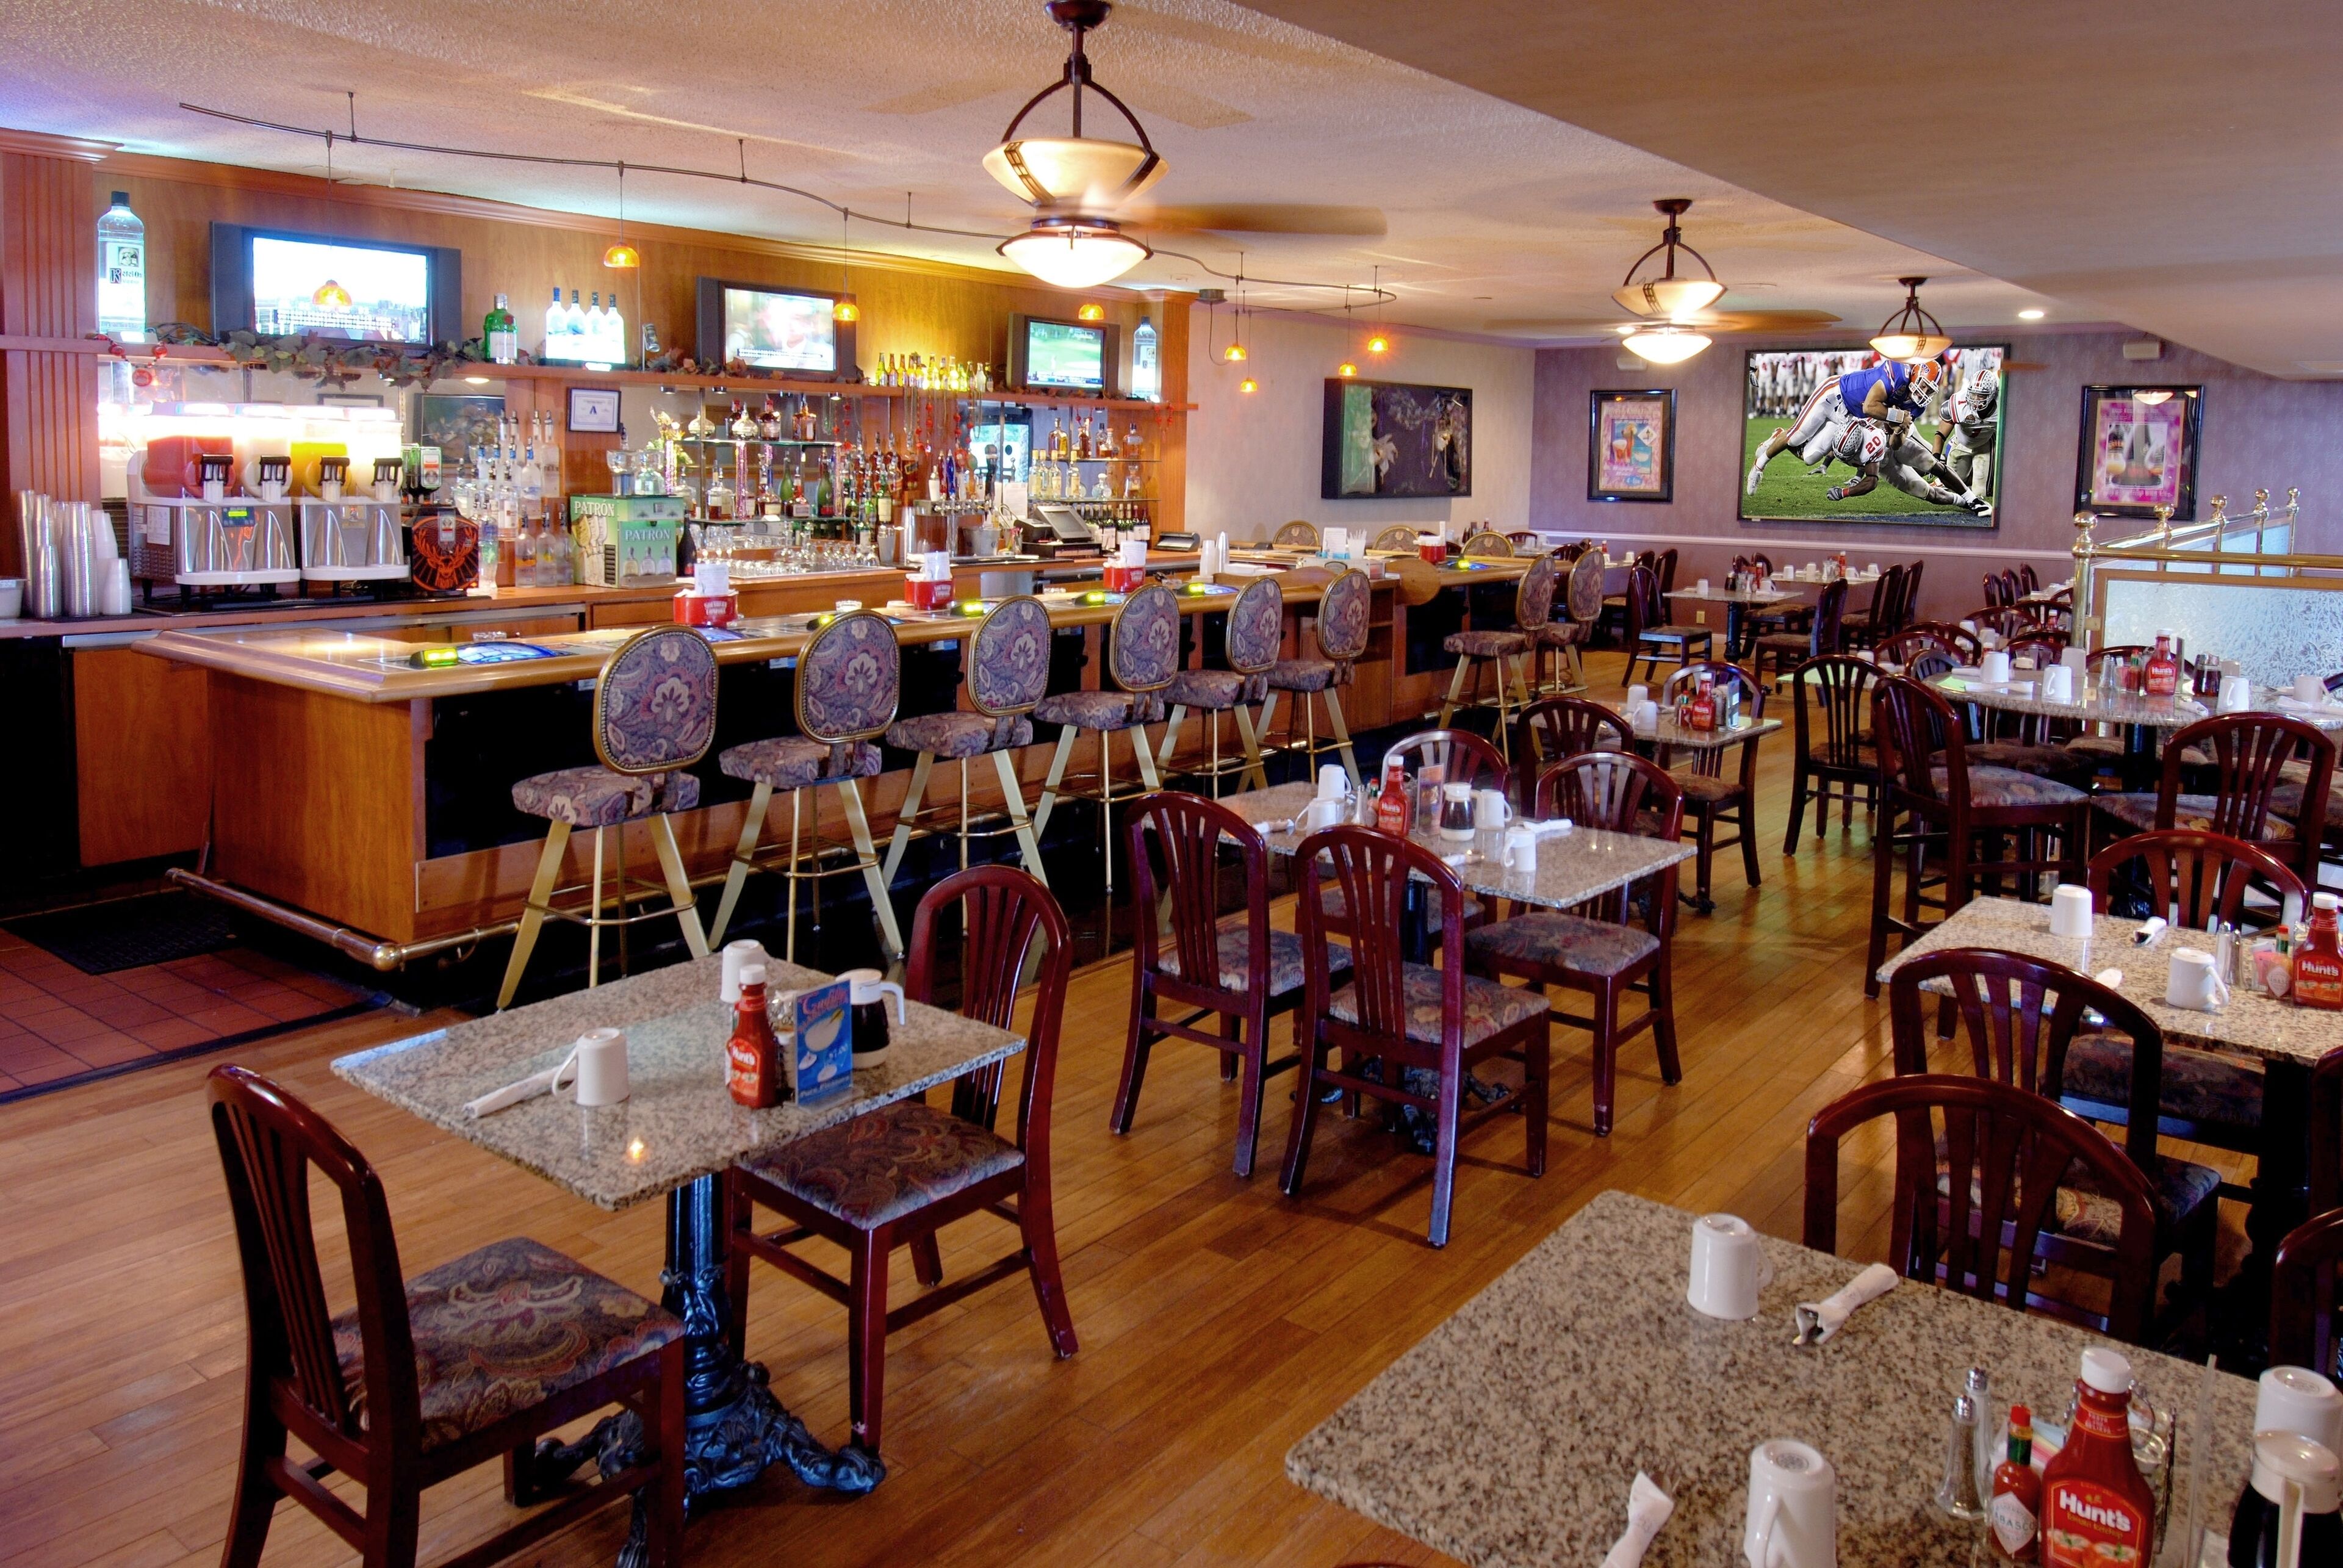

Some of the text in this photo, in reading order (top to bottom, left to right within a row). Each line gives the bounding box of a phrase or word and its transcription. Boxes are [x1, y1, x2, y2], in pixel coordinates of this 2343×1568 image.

[1865, 436, 1881, 455] 20
[574, 500, 614, 517] PATRÓN
[2302, 960, 2339, 976] Hunt's
[2060, 1488, 2131, 1532] Hunt's
